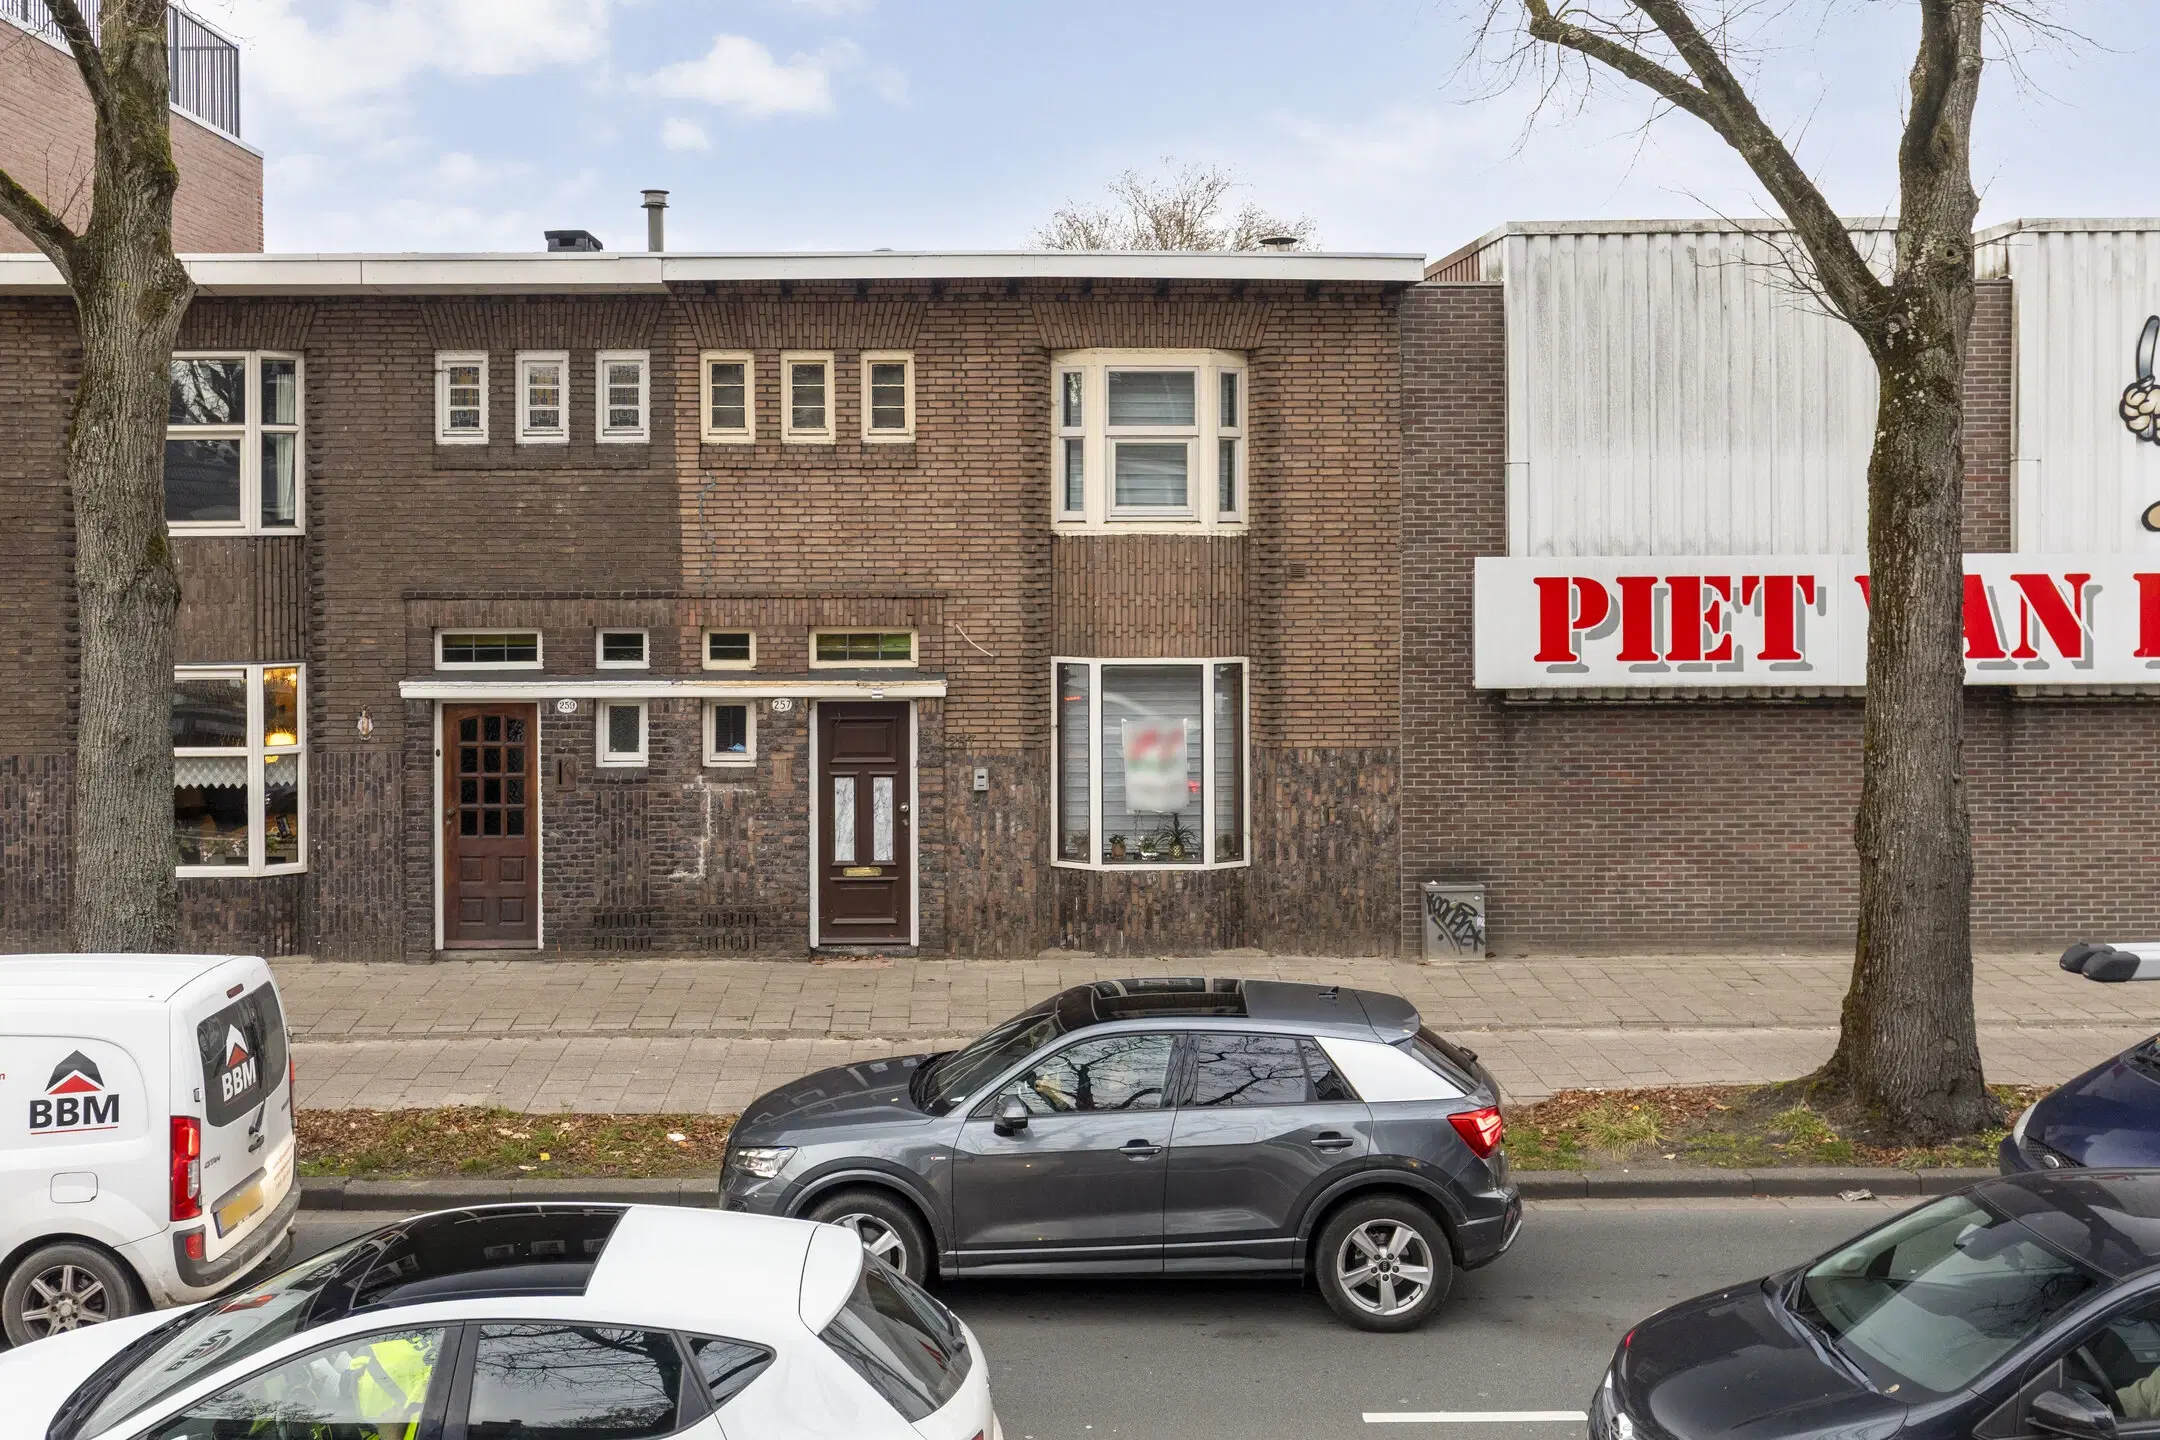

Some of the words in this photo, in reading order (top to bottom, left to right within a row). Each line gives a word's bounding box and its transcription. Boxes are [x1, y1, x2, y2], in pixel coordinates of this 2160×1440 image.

[1533, 575, 1815, 662] PIET
[1854, 573, 2091, 660] AN
[559, 701, 576, 710] 259
[774, 700, 791, 710] 257
[221, 1056, 256, 1102] BBM
[29, 1093, 119, 1129] BBM
